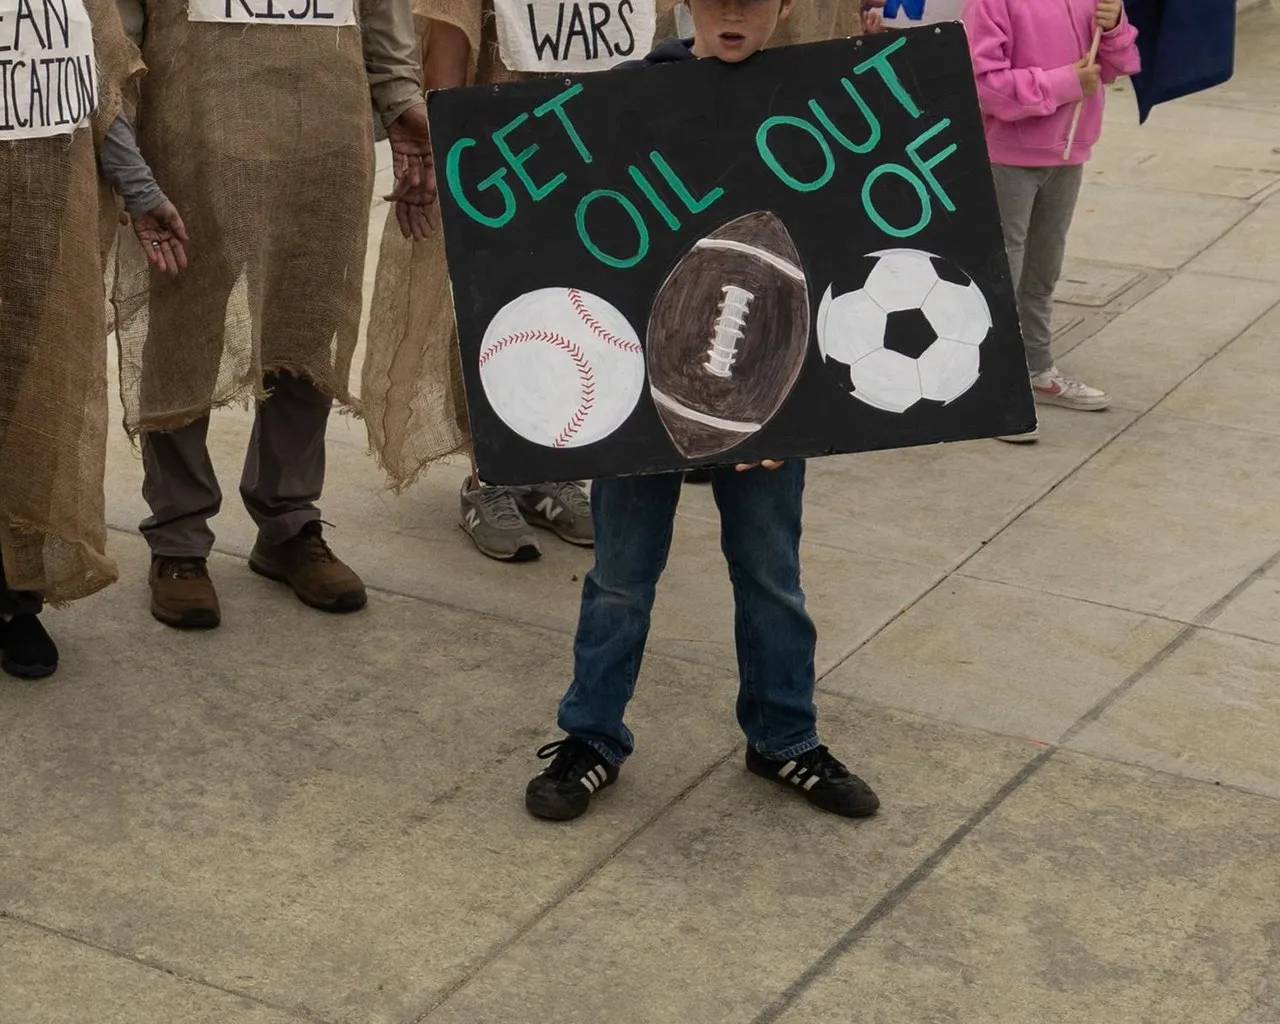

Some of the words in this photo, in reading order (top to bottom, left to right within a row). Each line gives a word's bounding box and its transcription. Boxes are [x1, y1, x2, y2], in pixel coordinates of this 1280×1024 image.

[446, 83, 592, 228] GET
[574, 150, 725, 268] OIL
[756, 36, 924, 192] OUT
[861, 118, 958, 238] OF
